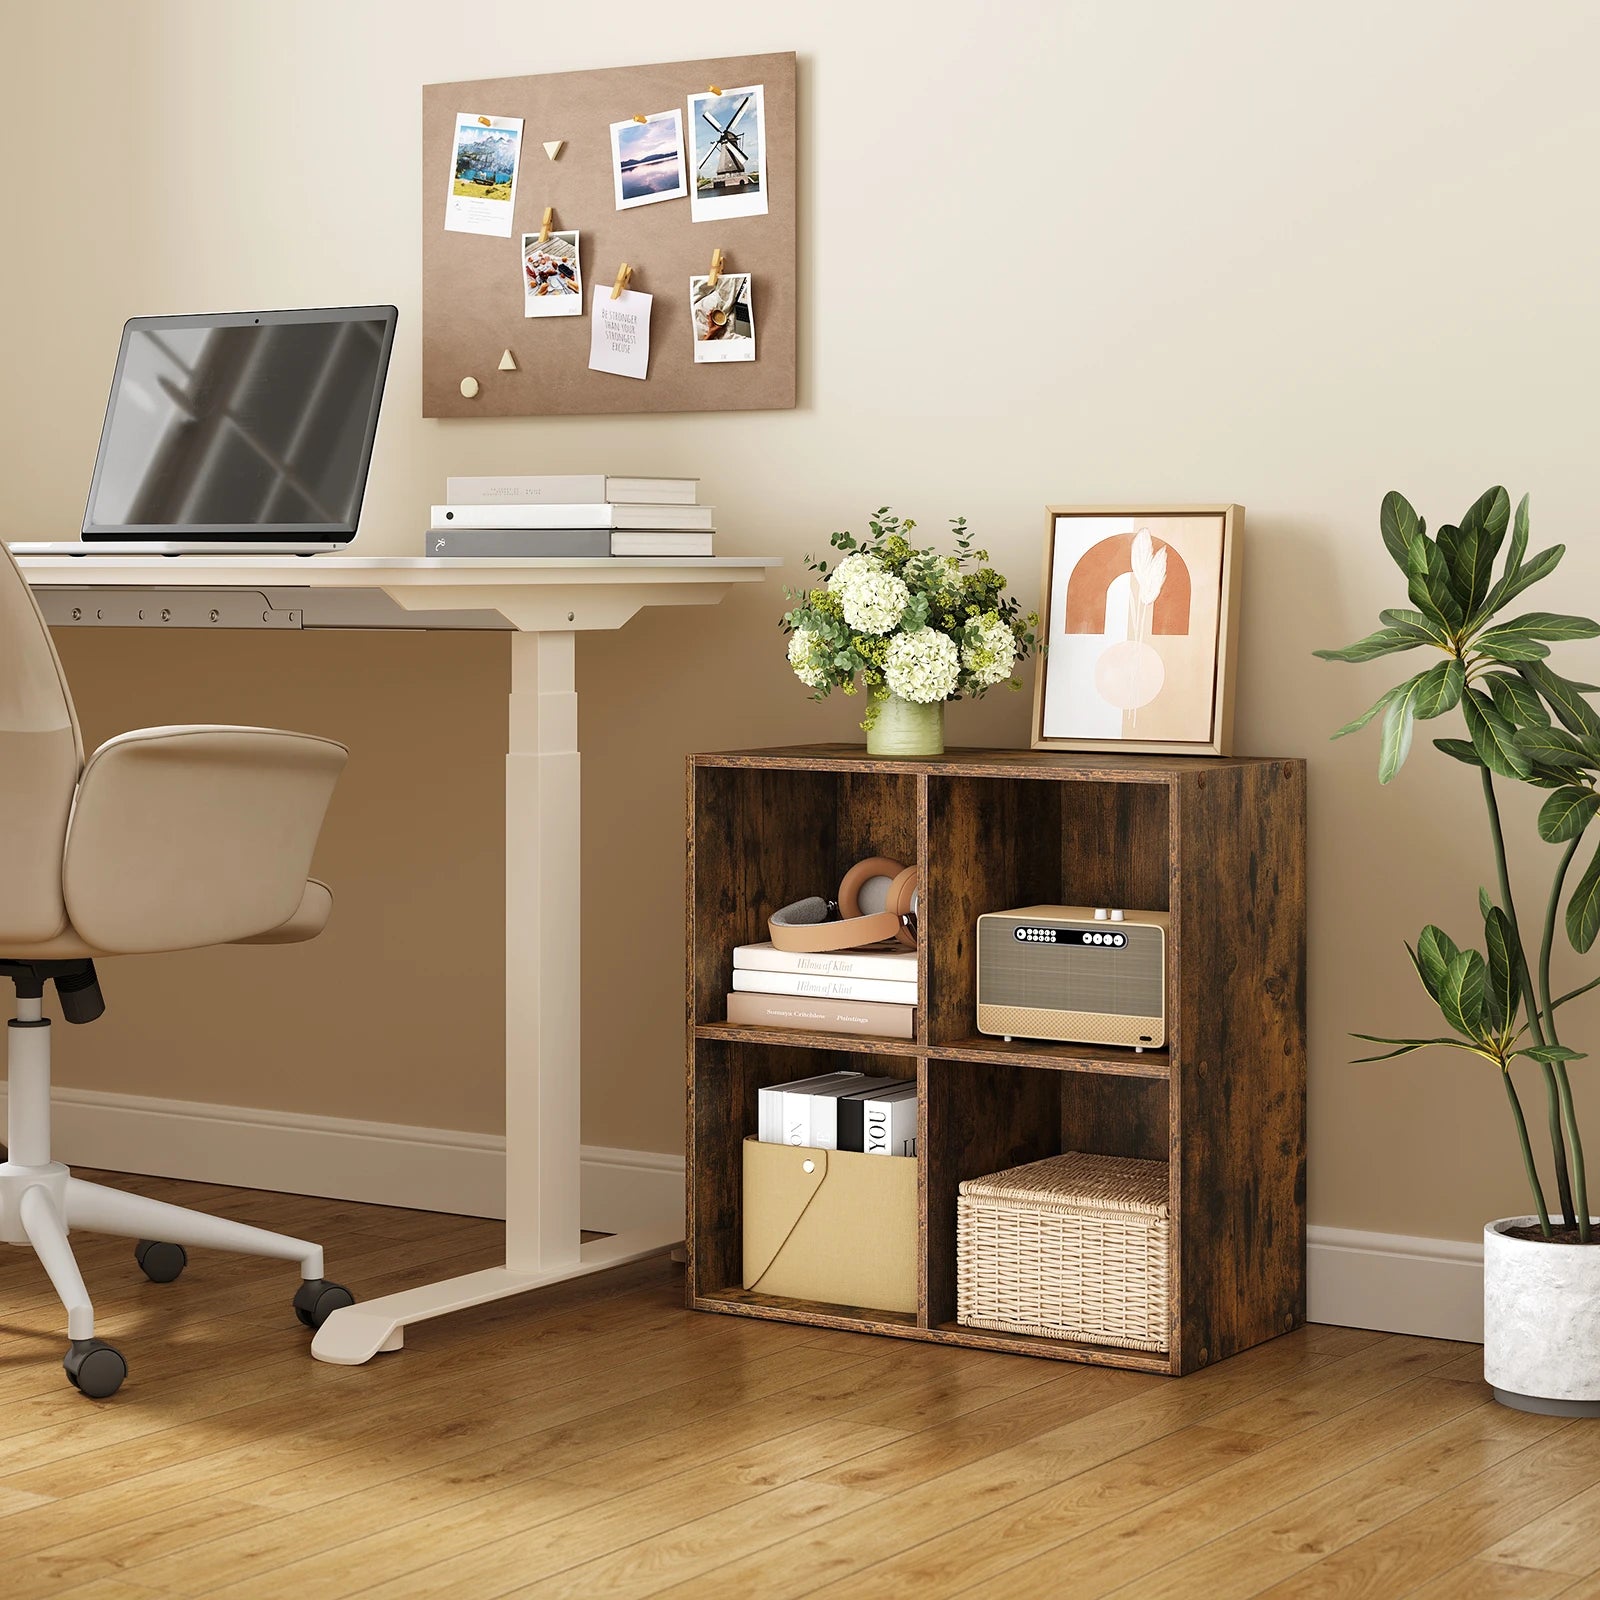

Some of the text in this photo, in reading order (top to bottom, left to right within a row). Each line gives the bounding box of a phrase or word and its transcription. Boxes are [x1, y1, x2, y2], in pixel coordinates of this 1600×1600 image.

[609, 311, 637, 324] STRONGER
[604, 320, 635, 334] THAN YOUR
[605, 330, 637, 344] STRONGEST
[612, 342, 631, 354] EXCUSE
[868, 1110, 887, 1153] YOU
